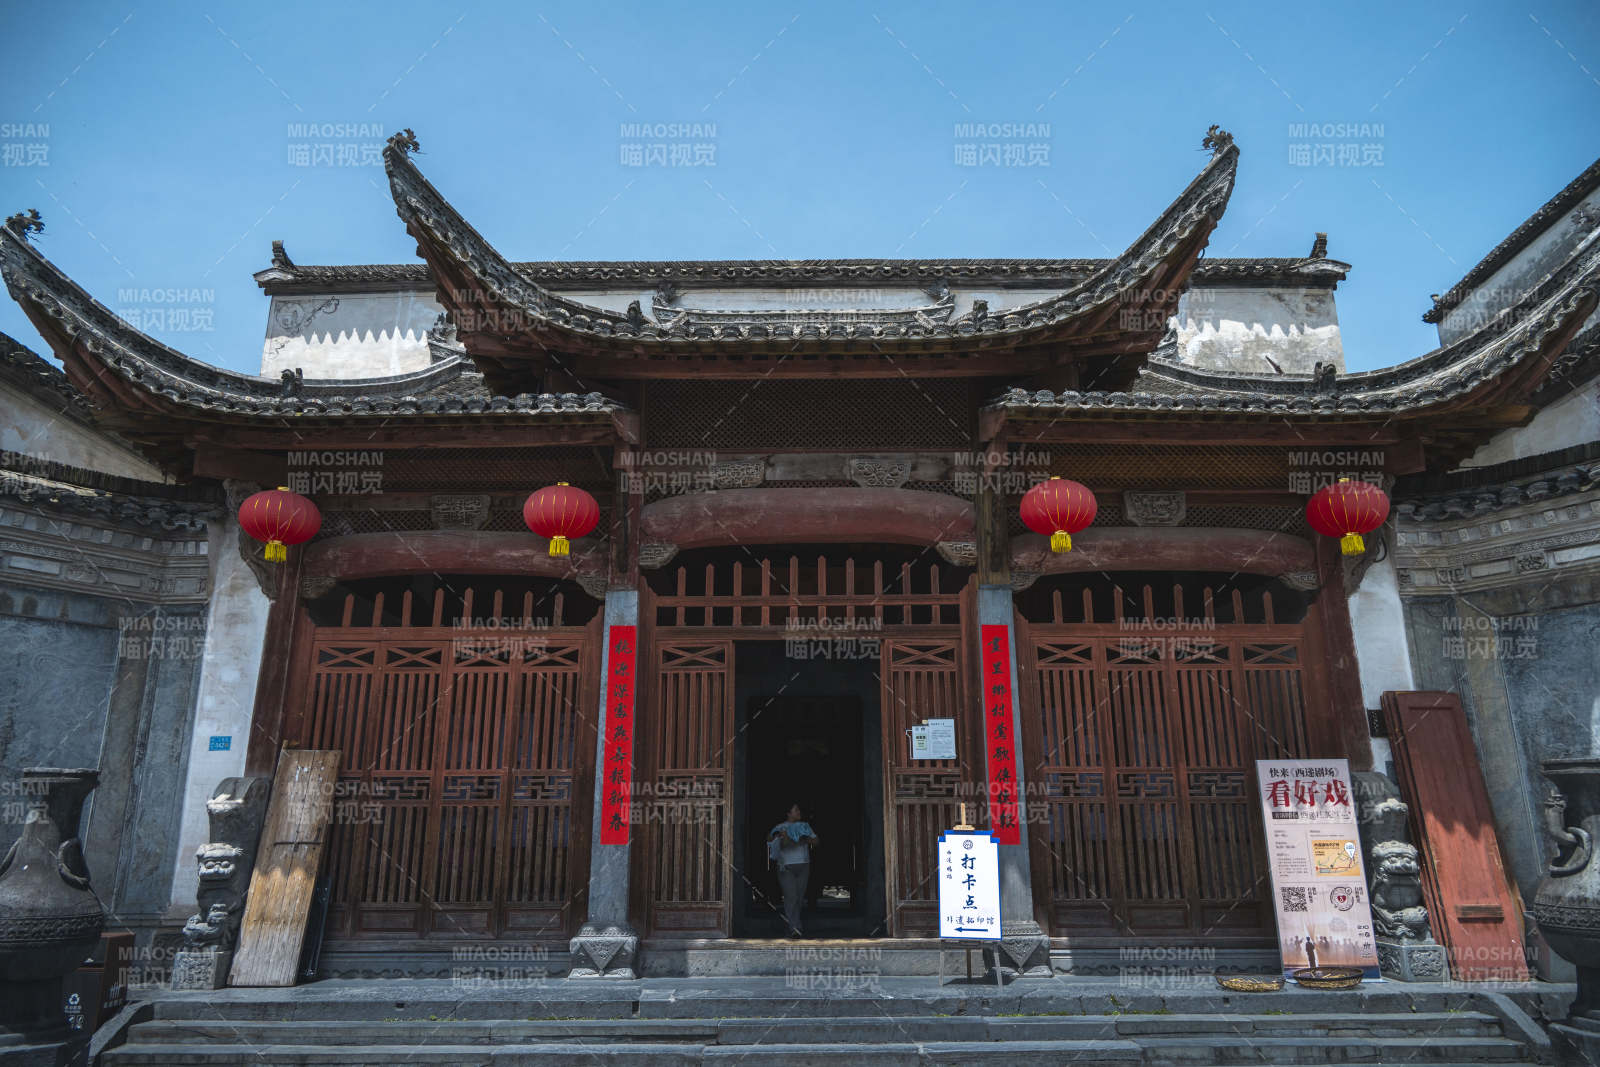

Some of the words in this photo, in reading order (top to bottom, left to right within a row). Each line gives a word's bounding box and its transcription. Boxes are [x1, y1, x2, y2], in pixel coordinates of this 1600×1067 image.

[1264, 778, 1351, 808] 看好戏
[961, 853, 978, 910] 打卡点
